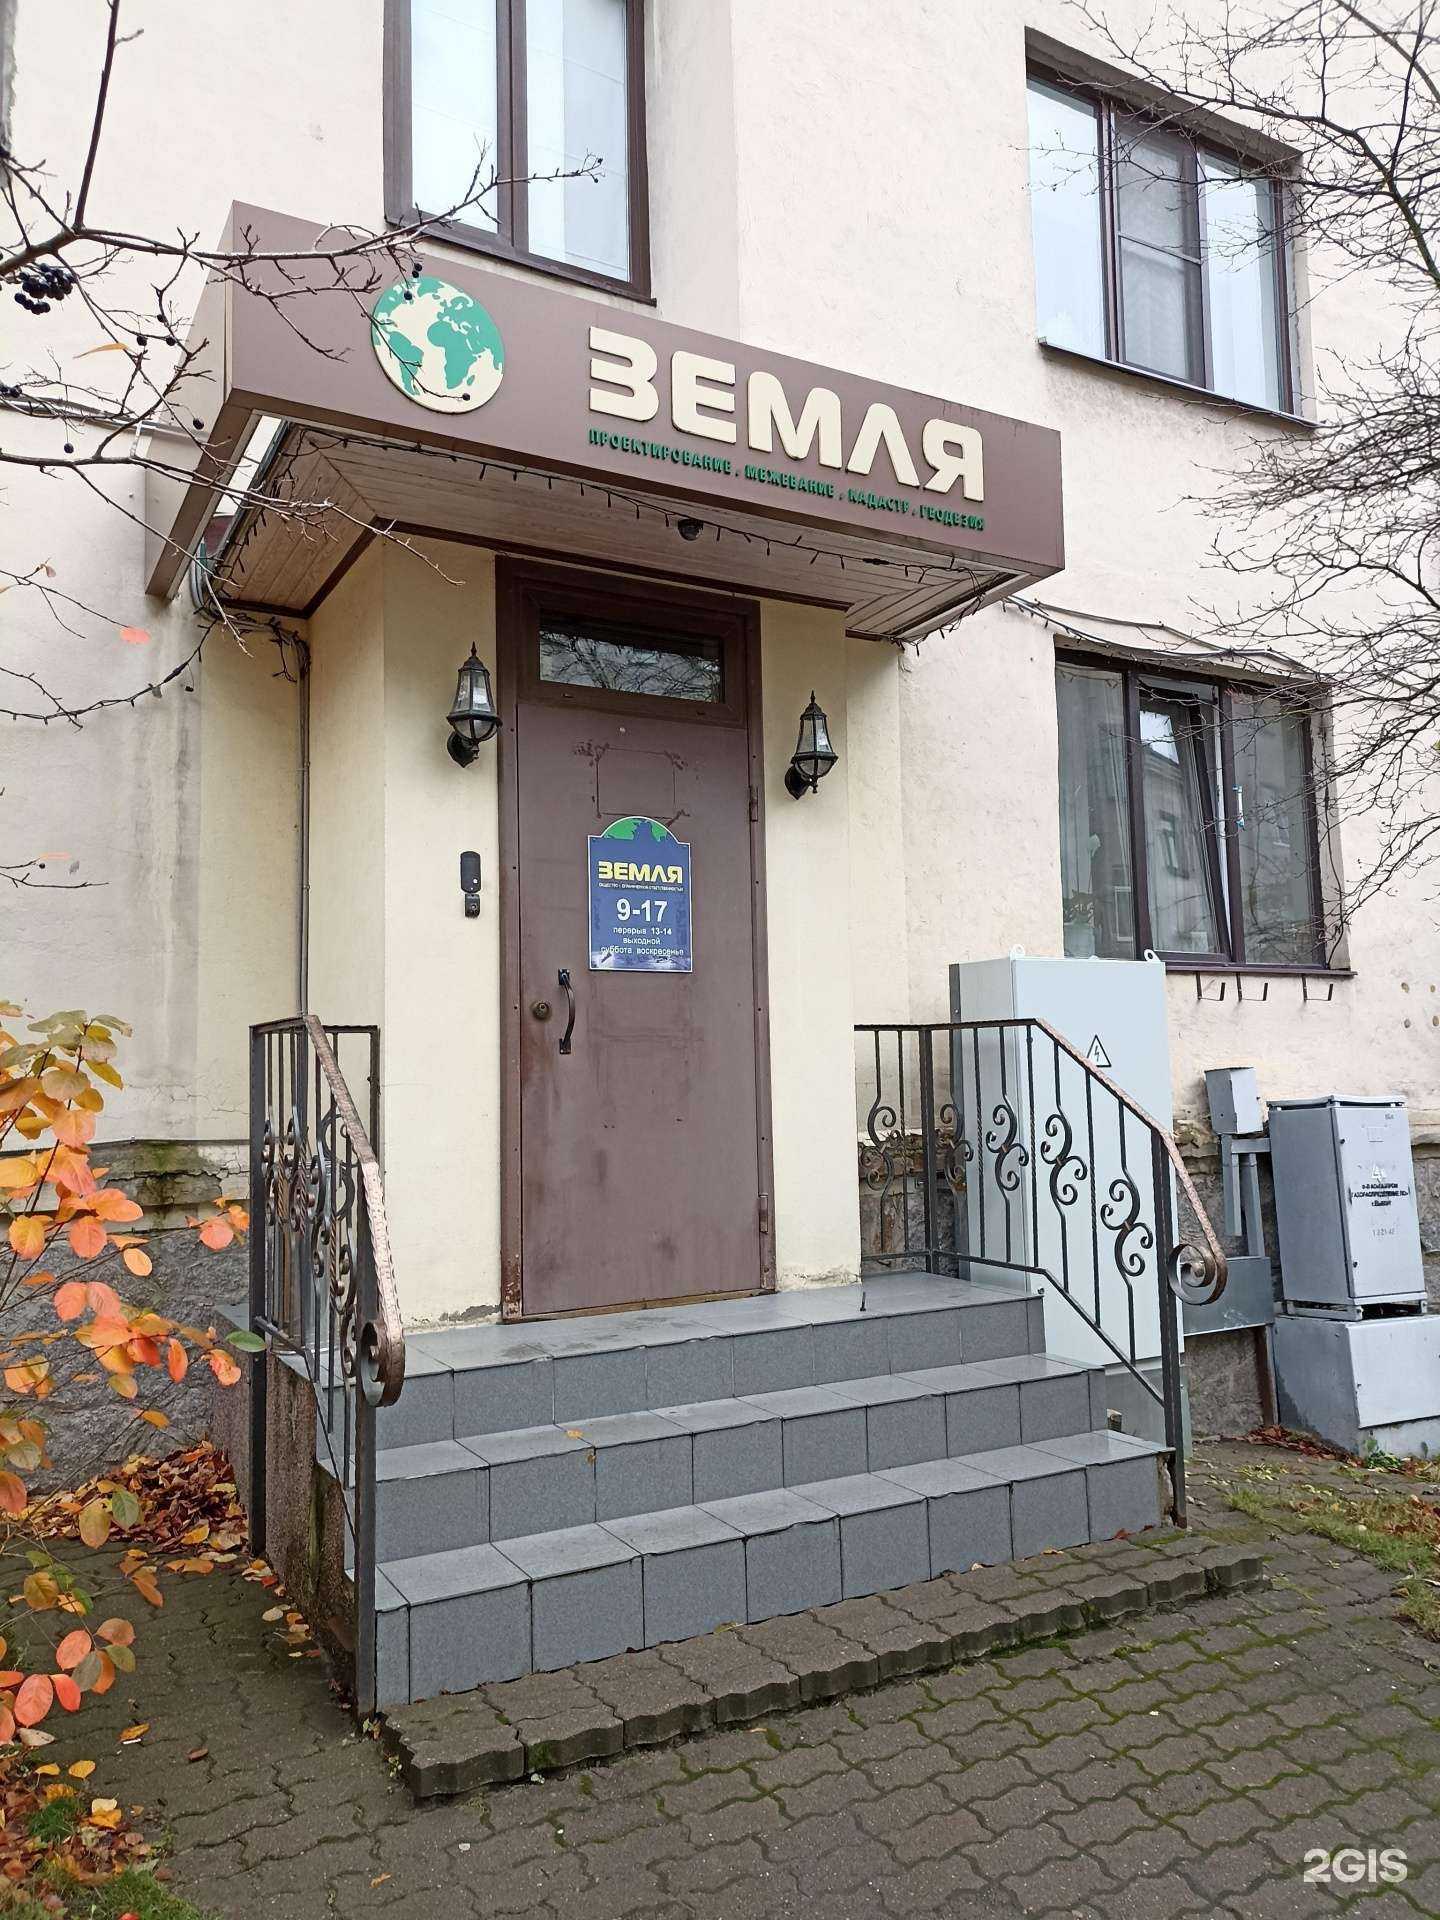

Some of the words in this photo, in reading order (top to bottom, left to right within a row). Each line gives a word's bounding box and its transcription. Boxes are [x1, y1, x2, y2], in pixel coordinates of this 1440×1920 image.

[588, 326, 984, 502] ЗЕМЛЯ
[588, 429, 732, 477] ПРОЕКТИРОВАНИЕ
[744, 464, 835, 497] МЕЖЕВАНИЕ
[848, 488, 910, 514] КАДАСТР
[919, 505, 984, 531] ГЕОДЕЗИЯ
[598, 861, 683, 884] ЗЕМЛЯ
[616, 898, 668, 922] 9-17
[613, 927, 647, 935] перерыв
[651, 927, 672, 935] 13-14
[623, 937, 661, 945] выходной
